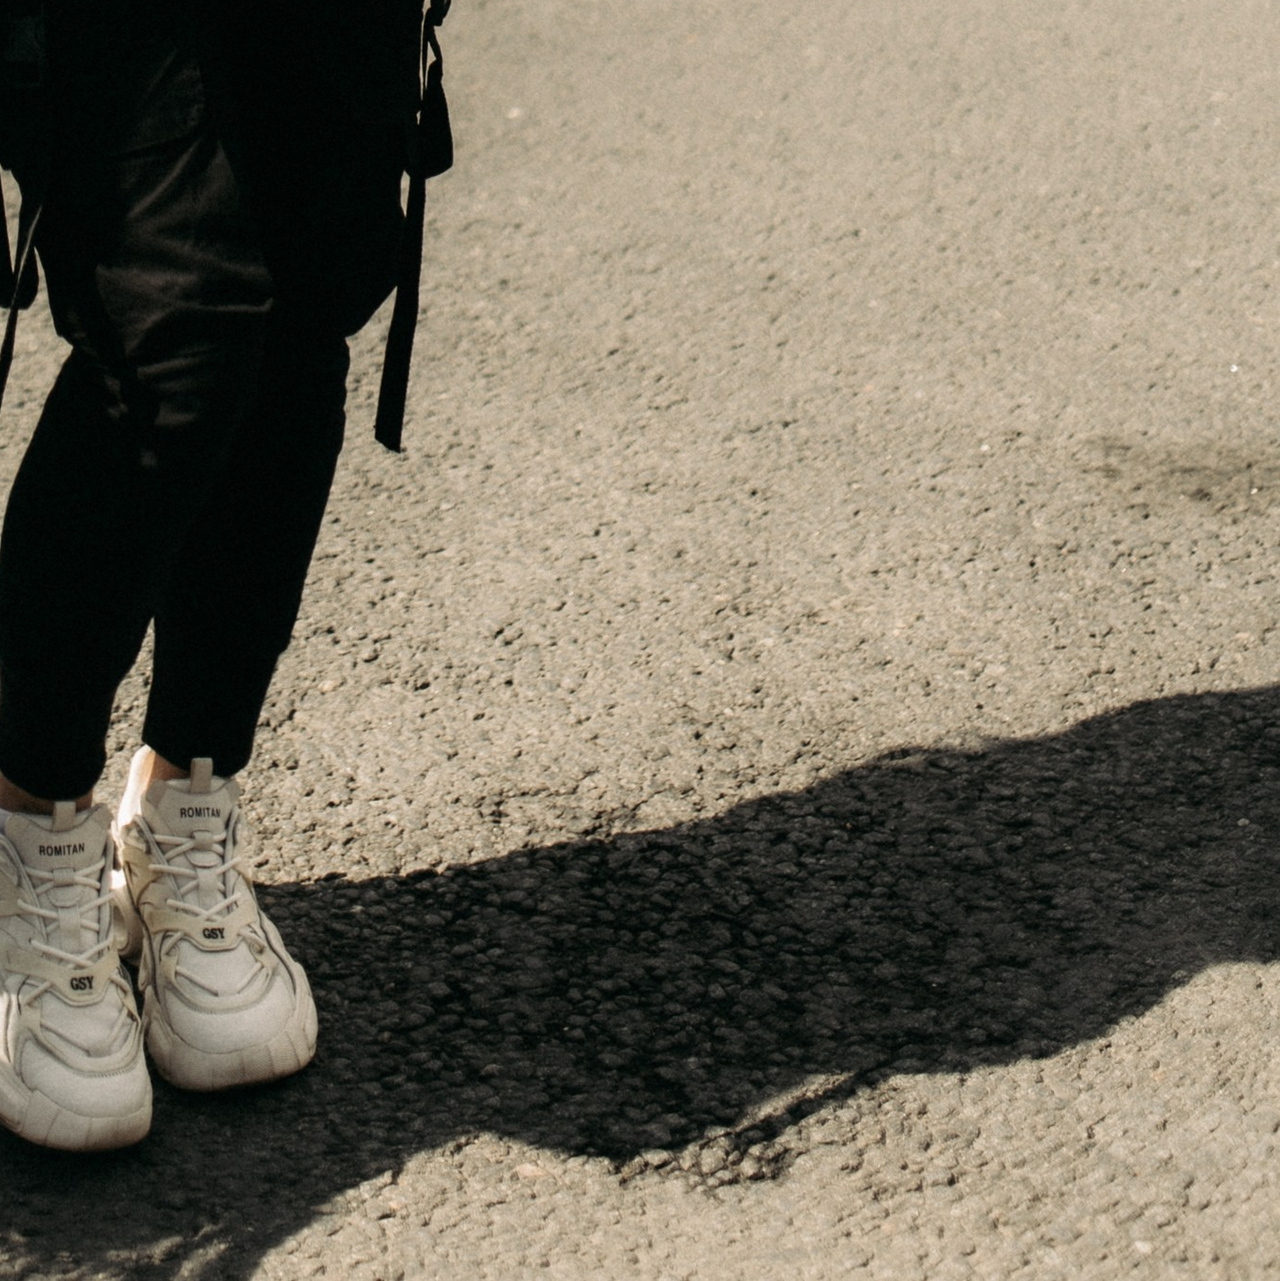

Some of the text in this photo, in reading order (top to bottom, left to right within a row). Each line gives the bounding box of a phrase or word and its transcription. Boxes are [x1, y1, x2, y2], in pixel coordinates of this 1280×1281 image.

[39, 842, 85, 857] ROMITAN
[202, 927, 225, 939] GSY
[70, 975, 94, 990] GSY
